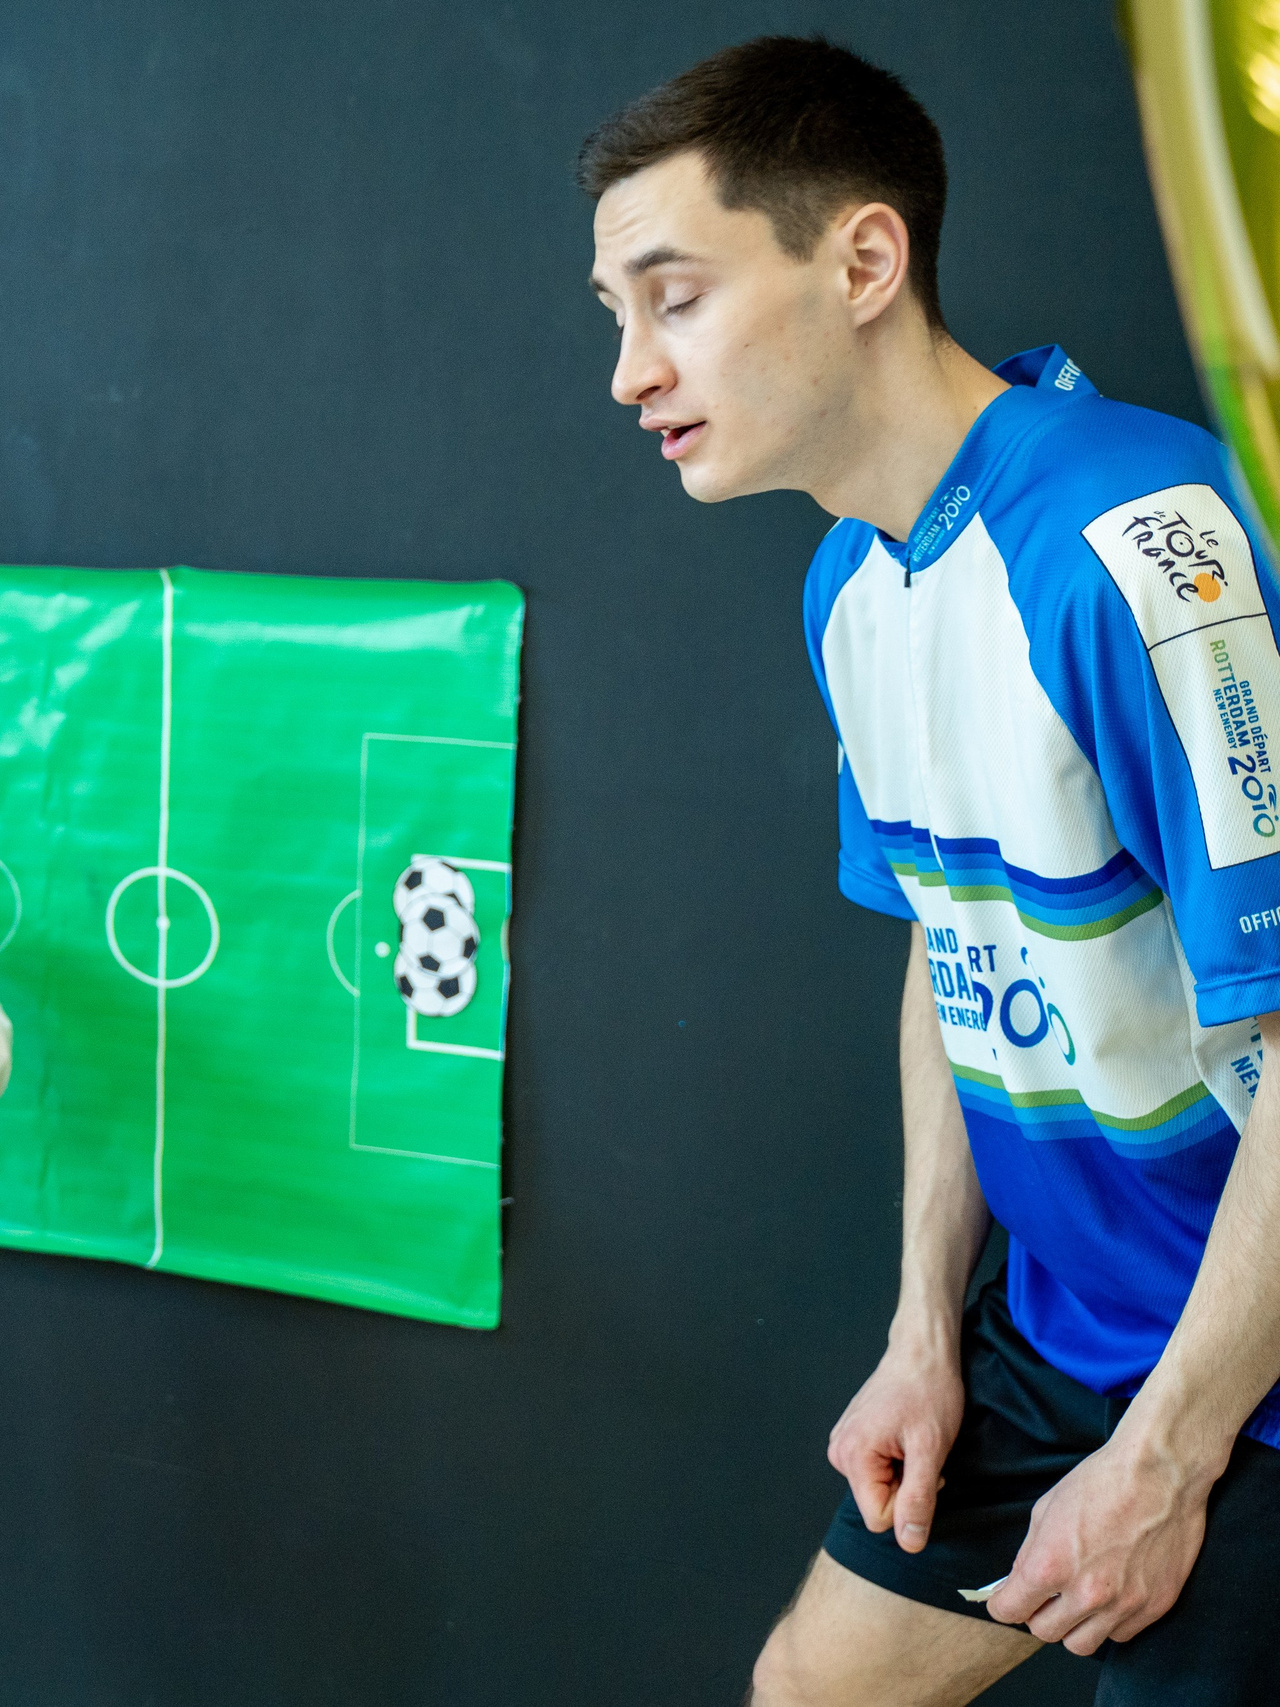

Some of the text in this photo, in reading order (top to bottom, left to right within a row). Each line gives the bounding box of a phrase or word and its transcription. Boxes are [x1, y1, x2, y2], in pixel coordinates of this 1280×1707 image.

[938, 486, 970, 530] 2010
[1209, 640, 1251, 748] ROTTERDAM
[1213, 688, 1238, 749] NEW ENERGY
[1239, 680, 1272, 773] GRAND DÉPART
[1227, 754, 1276, 838] 2010
[926, 926, 959, 954] AND
